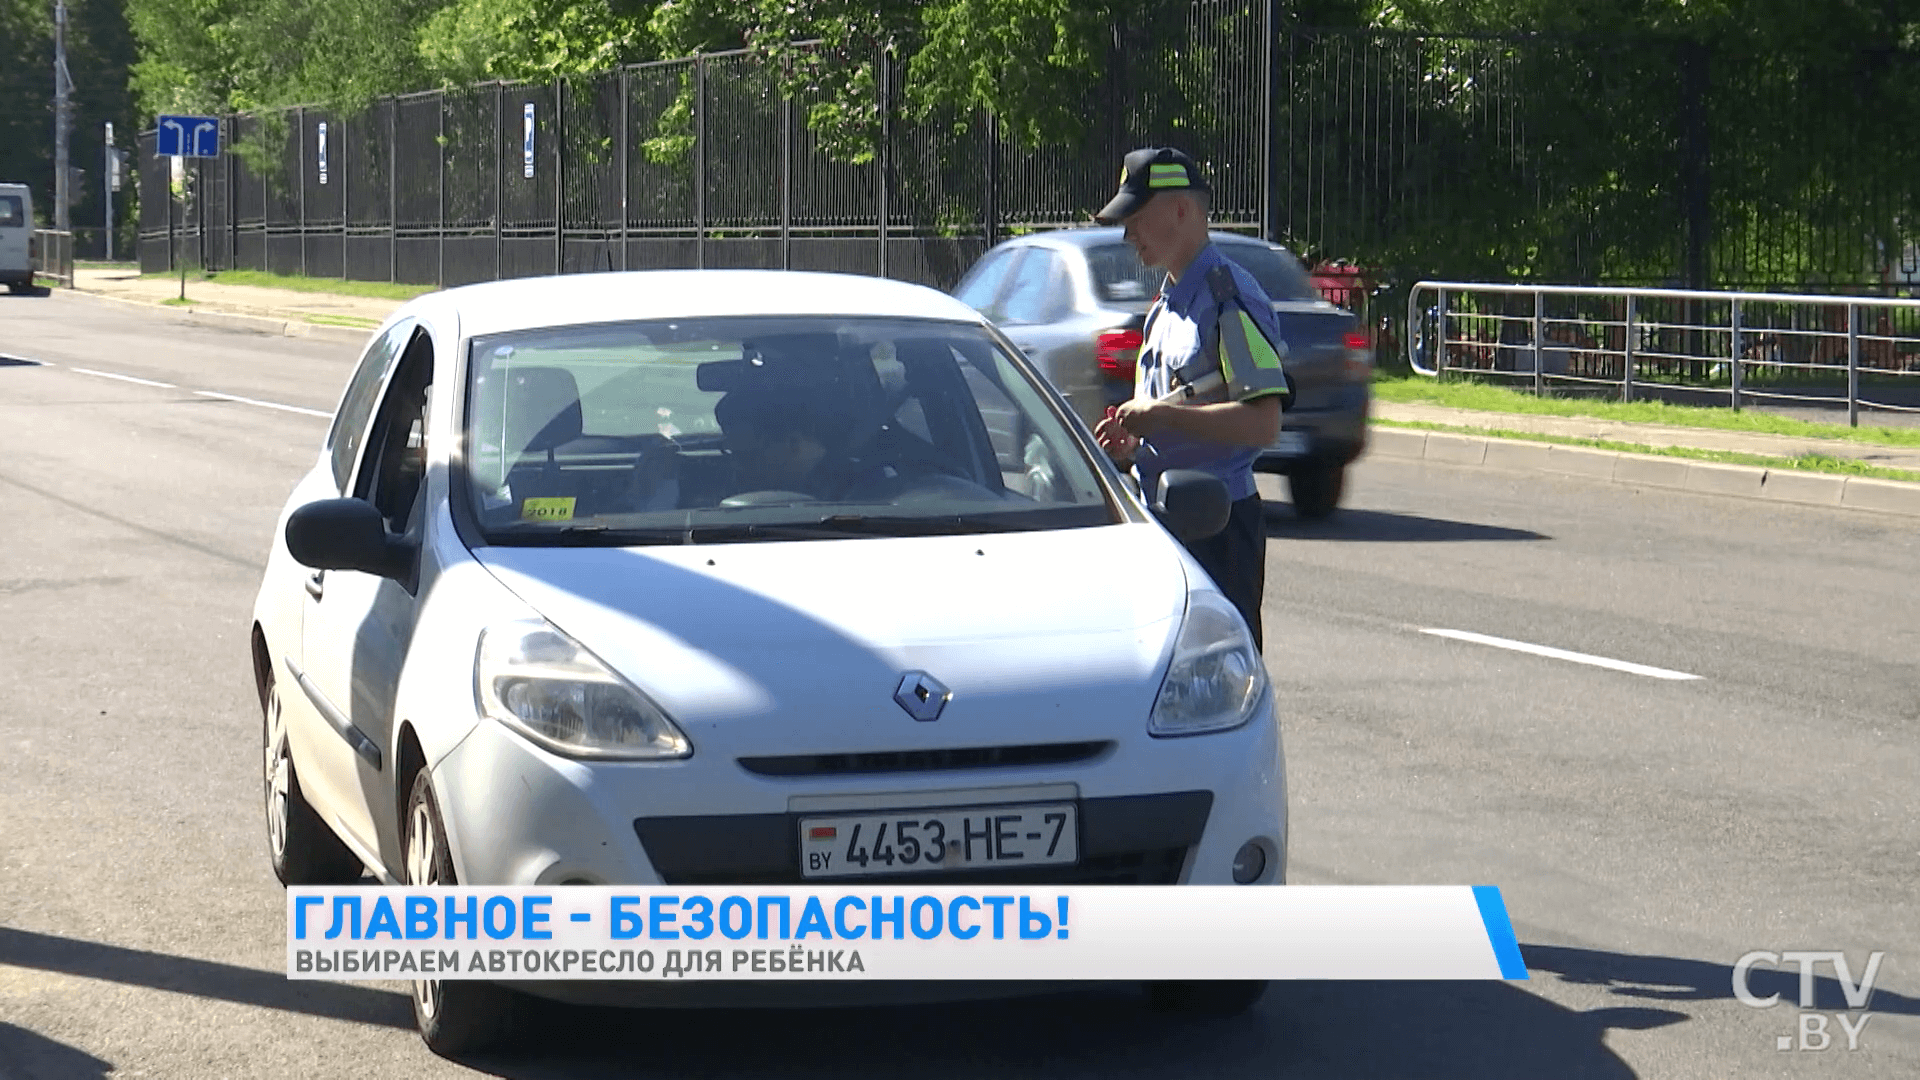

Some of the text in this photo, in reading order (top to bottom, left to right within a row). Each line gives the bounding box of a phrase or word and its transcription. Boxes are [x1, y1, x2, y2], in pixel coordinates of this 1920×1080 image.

[809, 813, 1067, 870] BY 4453 HE-7
